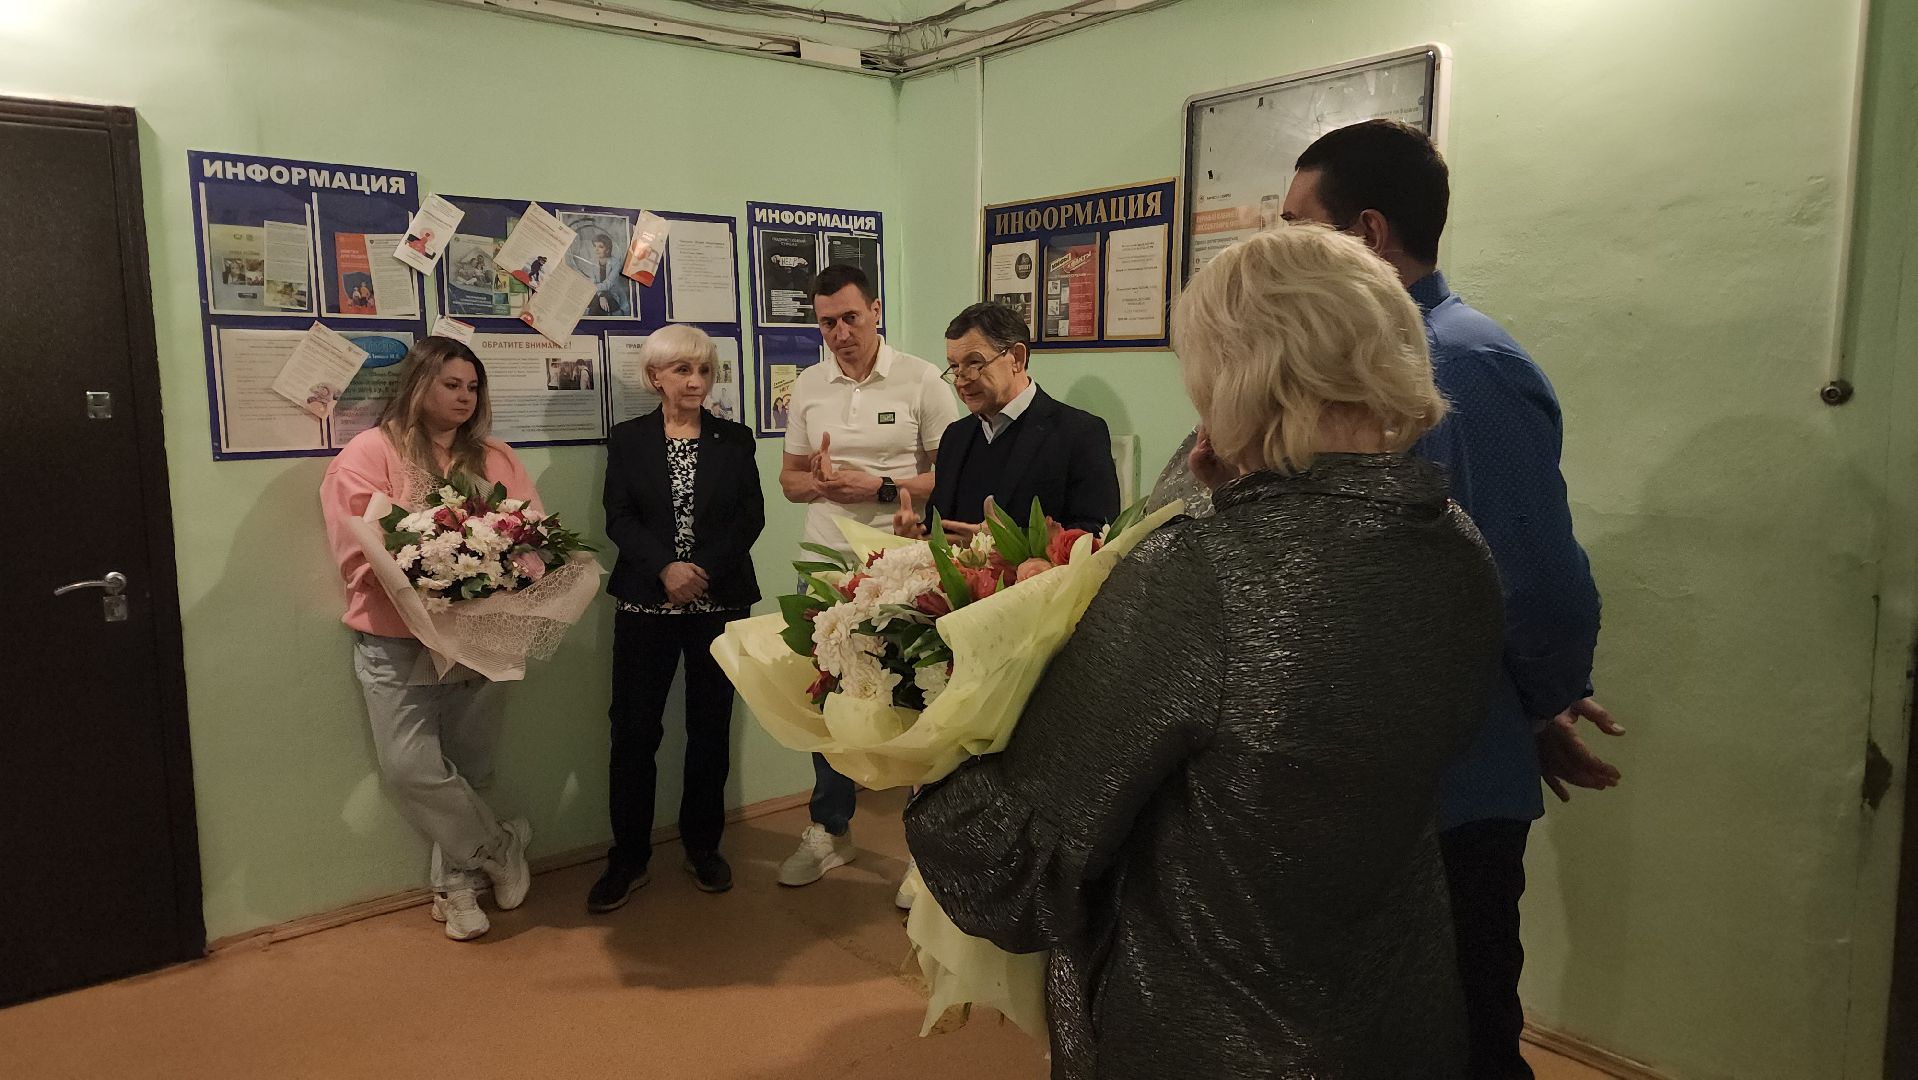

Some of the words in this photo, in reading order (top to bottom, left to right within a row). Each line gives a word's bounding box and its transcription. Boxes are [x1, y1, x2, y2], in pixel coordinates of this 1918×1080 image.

[202, 158, 406, 195] ИНФОРМАЦИЯ
[754, 207, 876, 231] ИНФОРМАЦИЯ
[994, 190, 1164, 236] ИНФОРМАЦИЯ
[481, 340, 524, 349] ОБРАТИТЕ
[525, 340, 572, 350] ВНИМАНЕ!
